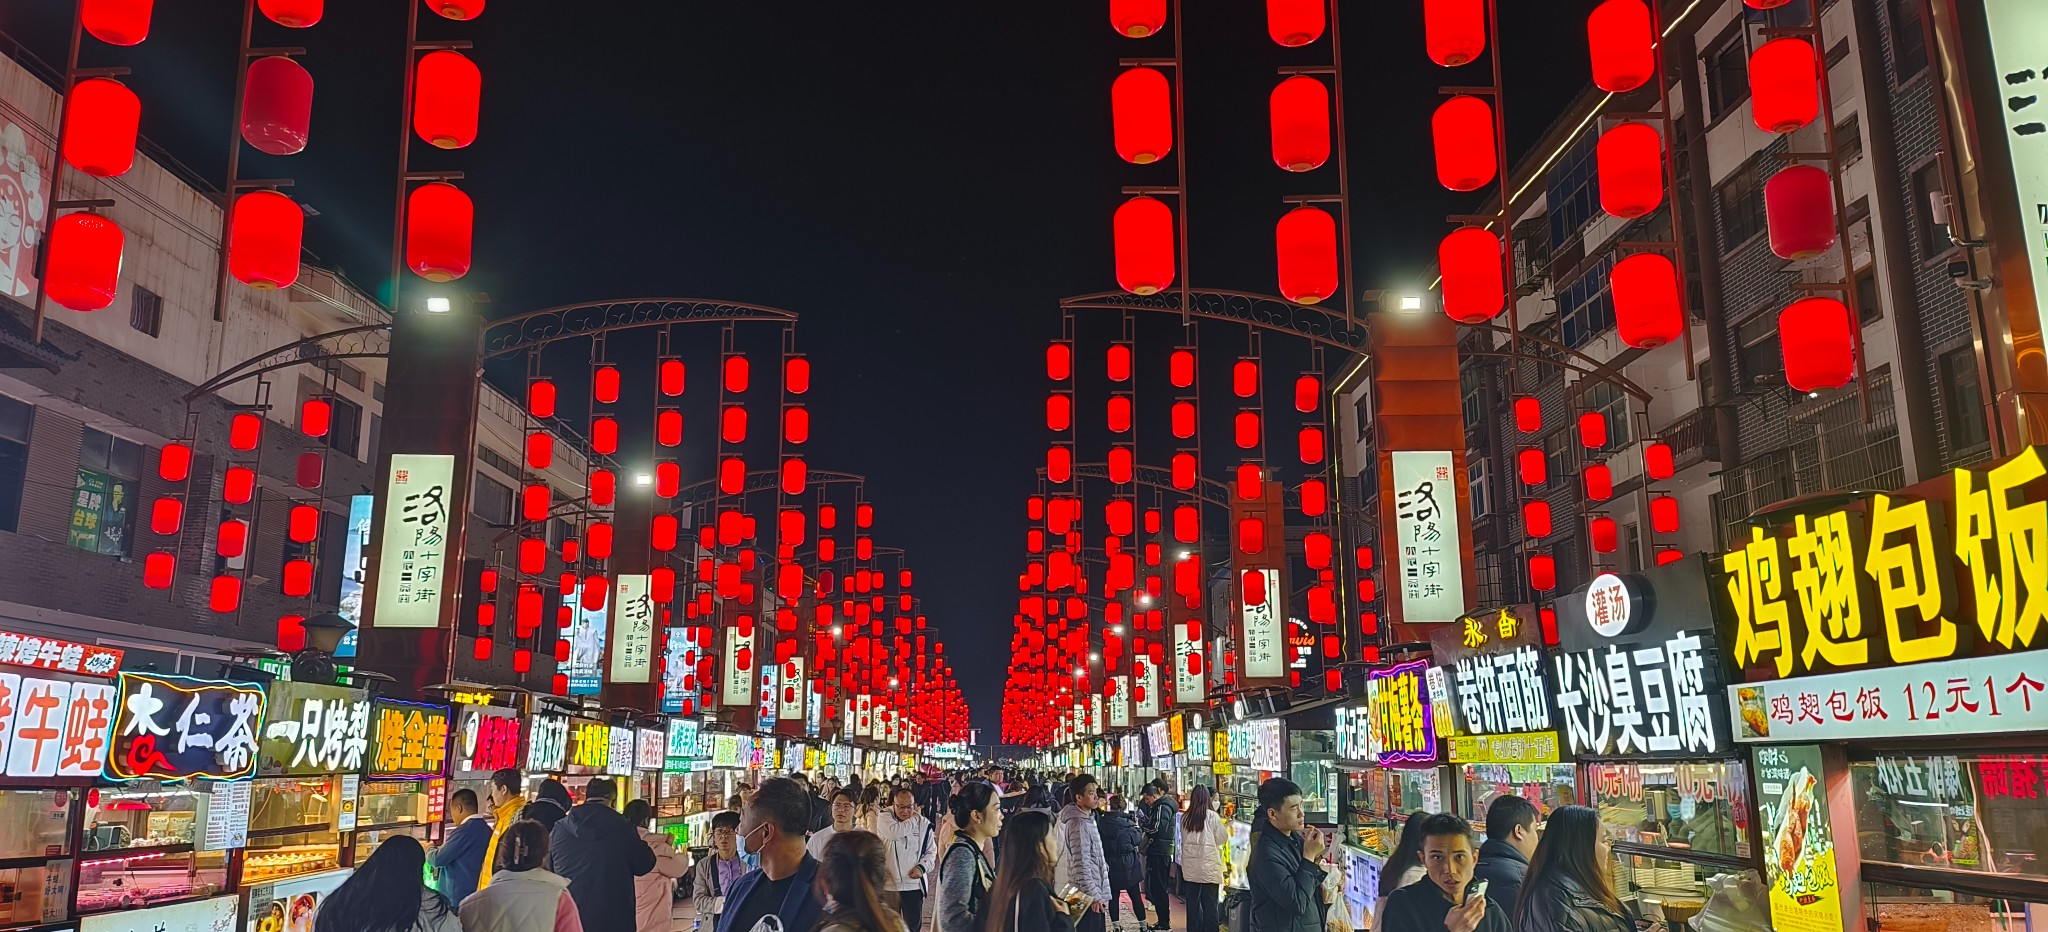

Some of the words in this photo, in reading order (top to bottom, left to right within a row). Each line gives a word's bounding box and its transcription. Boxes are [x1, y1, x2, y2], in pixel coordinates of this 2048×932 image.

[76, 490, 102, 511] 星牌
[1724, 445, 2048, 678] 鸡翅包饭
[1592, 584, 1630, 626] 灌汤
[1378, 670, 1426, 752] 甘梅薯条
[1456, 644, 1549, 734] 卷饼面筋
[1555, 630, 1715, 756] 长沙臭豆腐
[1770, 685, 1888, 726] 鸡翅包饭
[1902, 672, 2046, 722] 12元1个
[0, 678, 110, 772] 牛蛙
[266, 698, 370, 771] 一只烤梨
[375, 708, 447, 772] 烤全羊
[575, 723, 609, 767] 大唐排骨
[1492, 735, 1555, 760] 专业卷饼十五年
[1589, 760, 1643, 802] 10元1份
